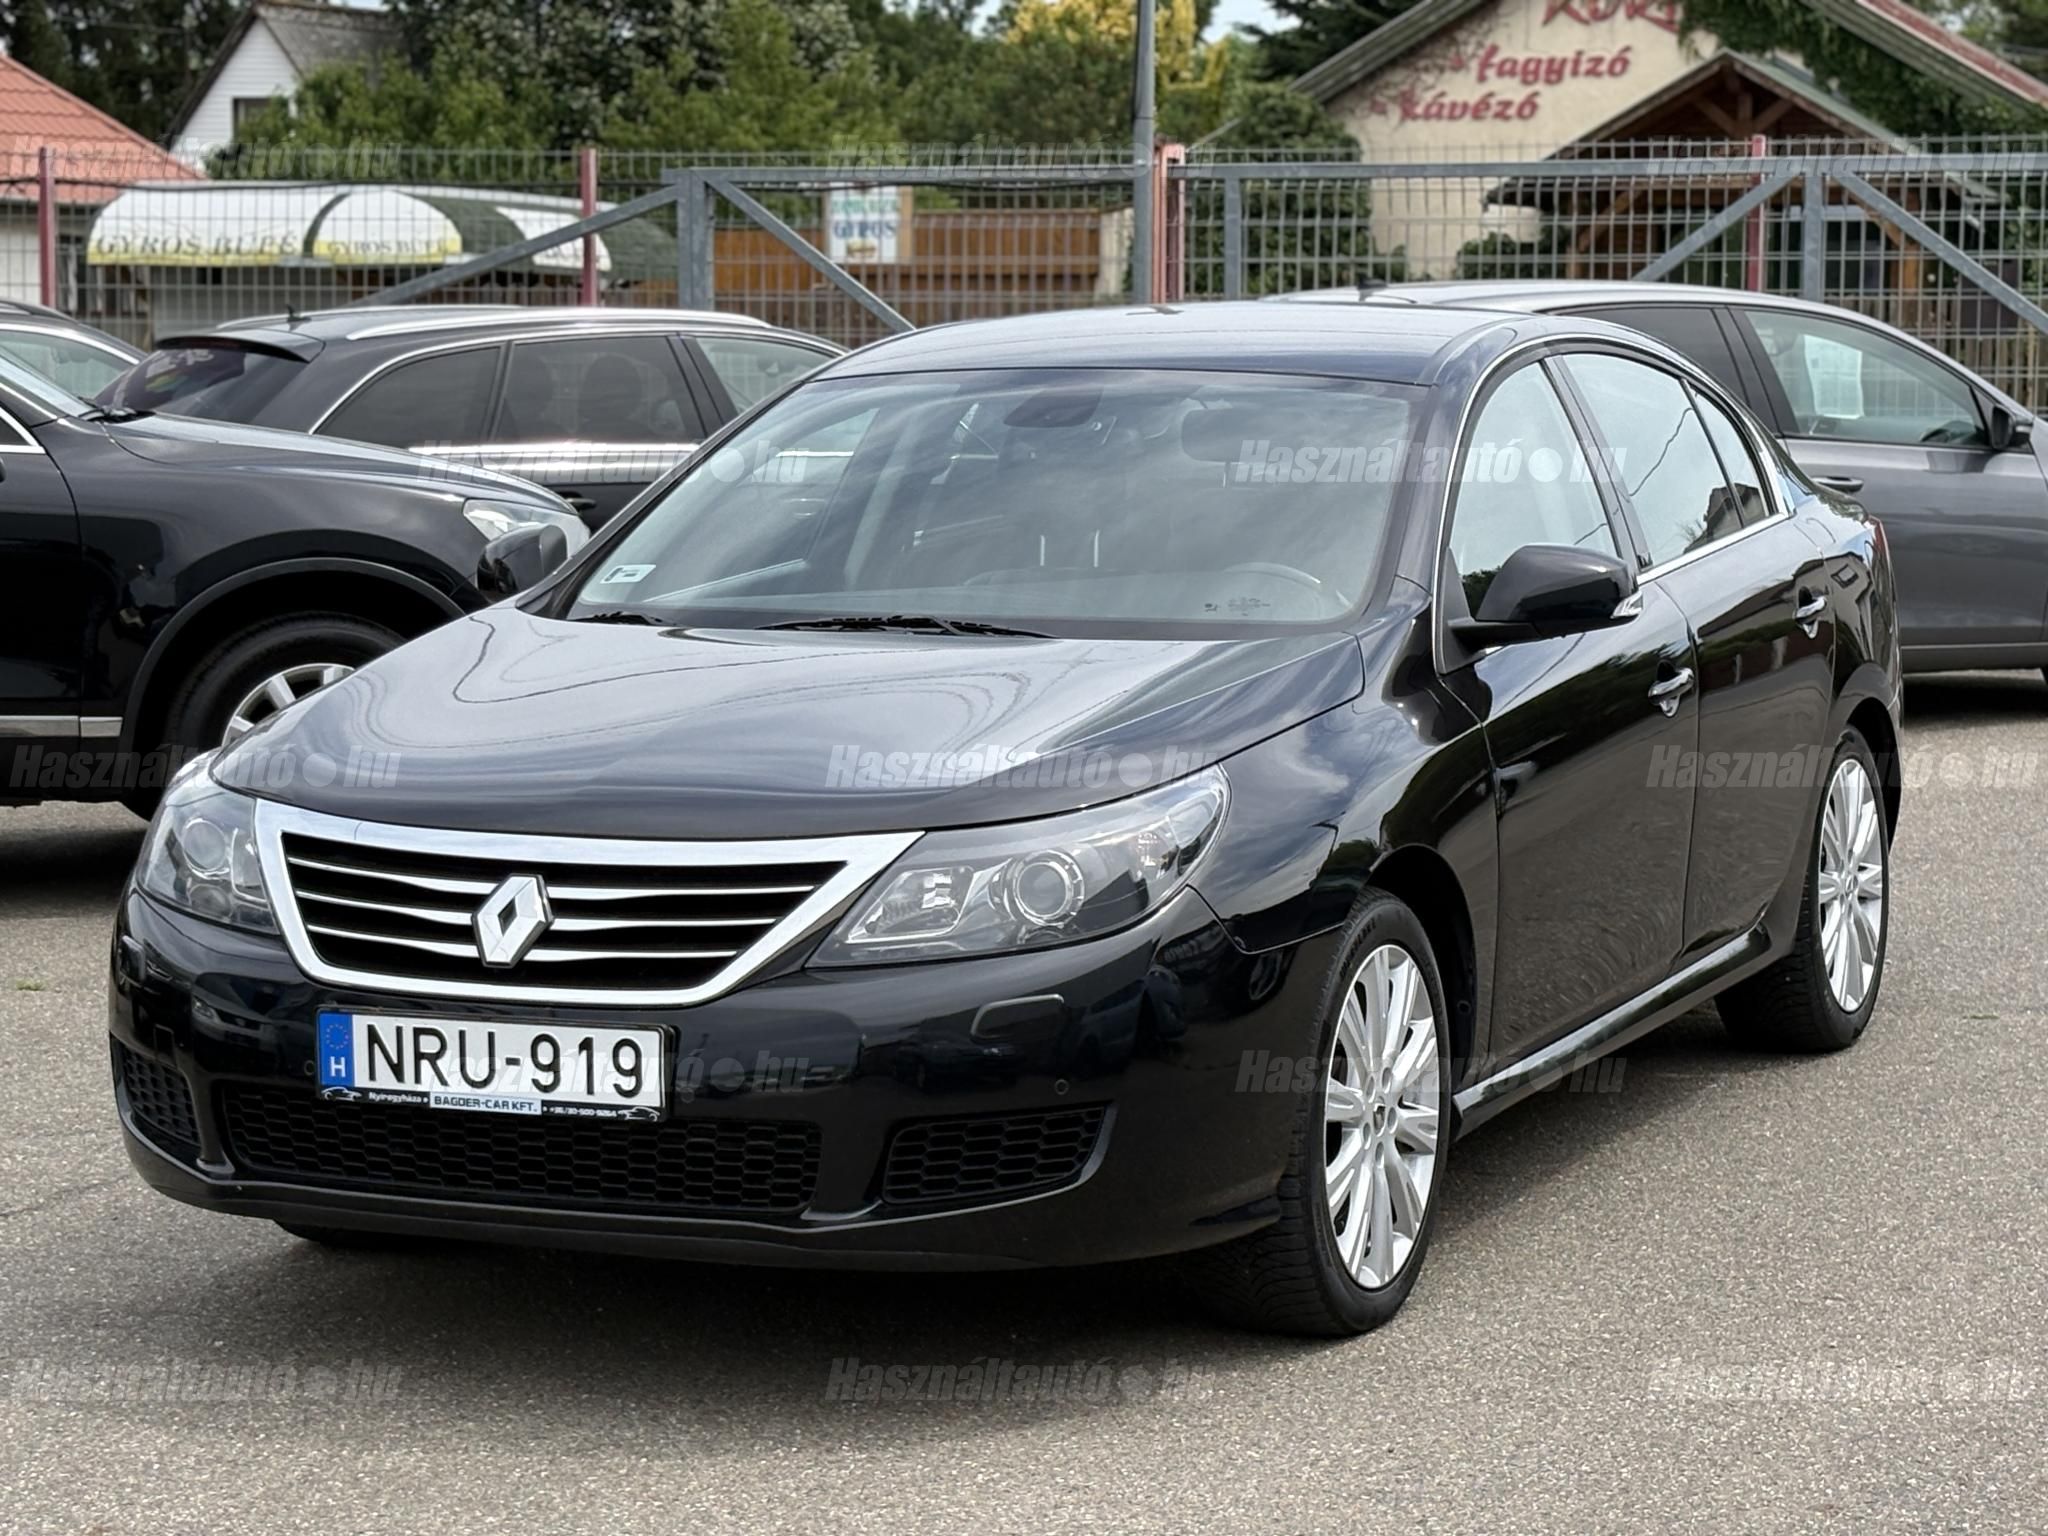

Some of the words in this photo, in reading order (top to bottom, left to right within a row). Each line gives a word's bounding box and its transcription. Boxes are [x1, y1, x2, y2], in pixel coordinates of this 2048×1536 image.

[1477, 44, 1632, 86] fagyizó
[330, 1056, 346, 1078] H
[367, 1024, 643, 1098] NRU-919
[434, 1096, 509, 1109] BAGDER-CAR
[512, 1101, 538, 1112] KFT.
